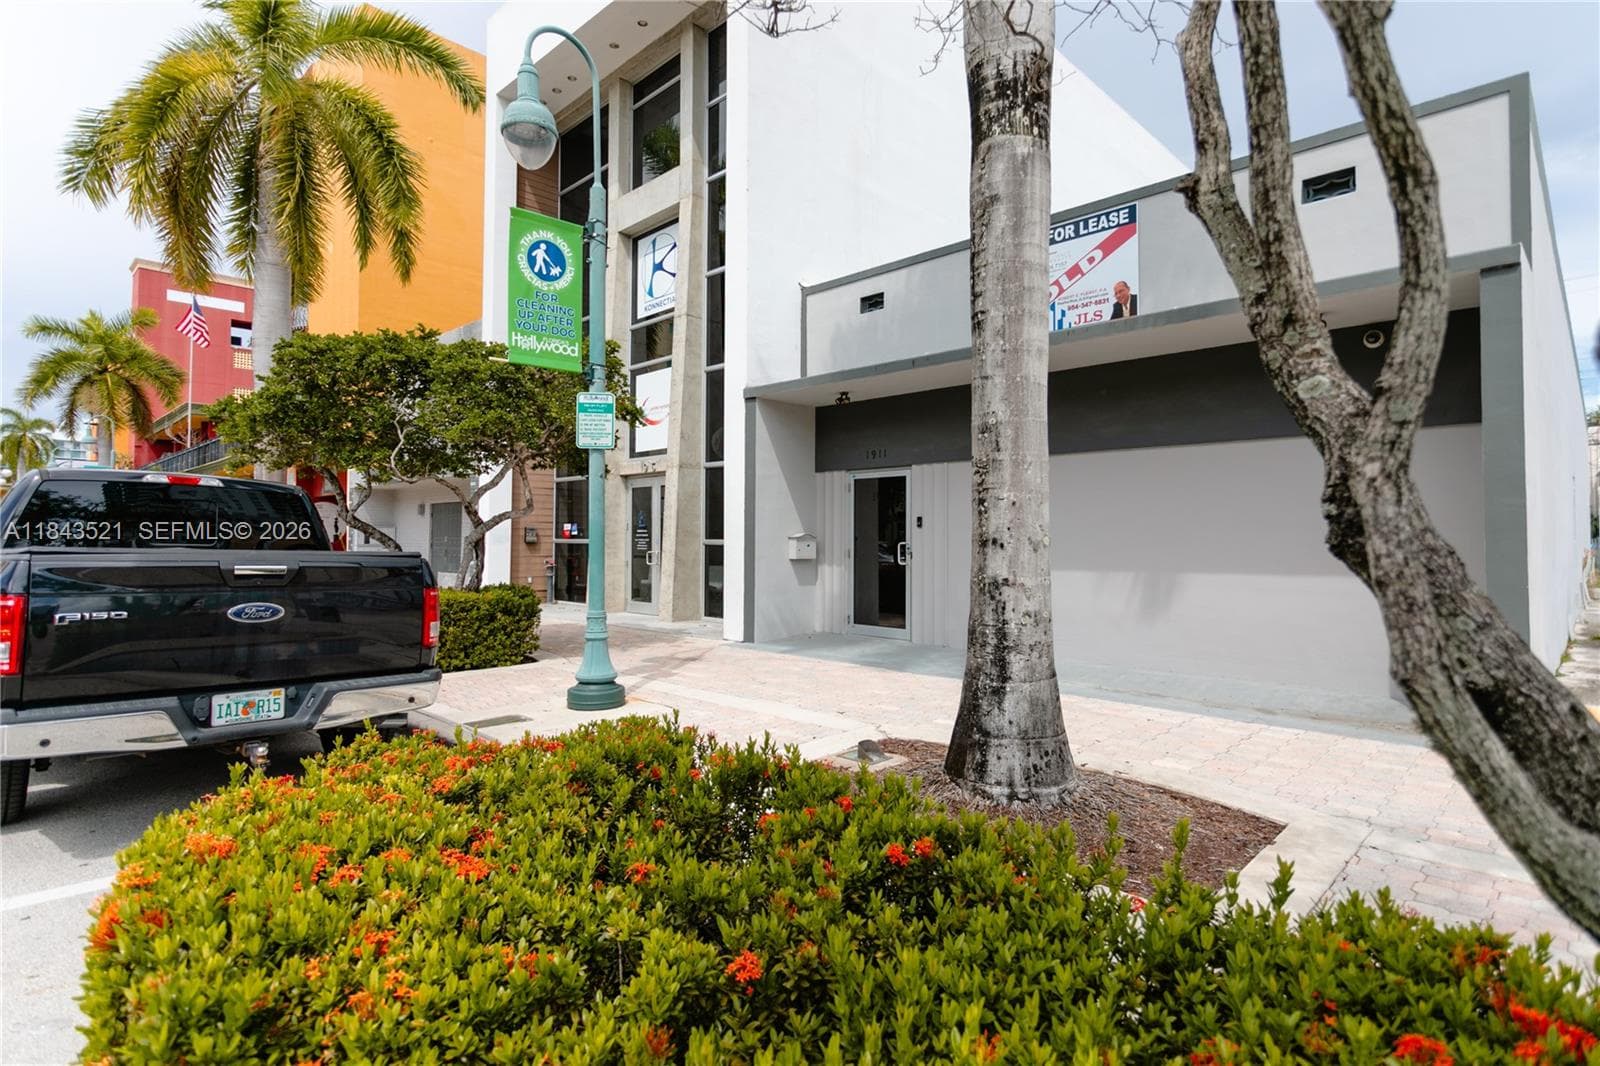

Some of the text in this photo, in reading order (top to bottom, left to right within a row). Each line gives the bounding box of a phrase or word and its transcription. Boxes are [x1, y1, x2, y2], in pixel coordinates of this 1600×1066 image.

[1080, 208, 1129, 235] LEASE
[520, 230, 574, 257] THANK YOU
[517, 253, 548, 290] GRACIAS
[553, 266, 575, 290] MERCI
[535, 290, 558, 302] FOR
[516, 298, 575, 317] CLEANING
[1074, 309, 1104, 325] JLS
[518, 309, 573, 327] UP AFTER
[515, 319, 576, 338] YOUR DOG
[511, 331, 579, 357] Hollywood
[866, 449, 887, 460] 1911
[240, 606, 273, 620] Ford
